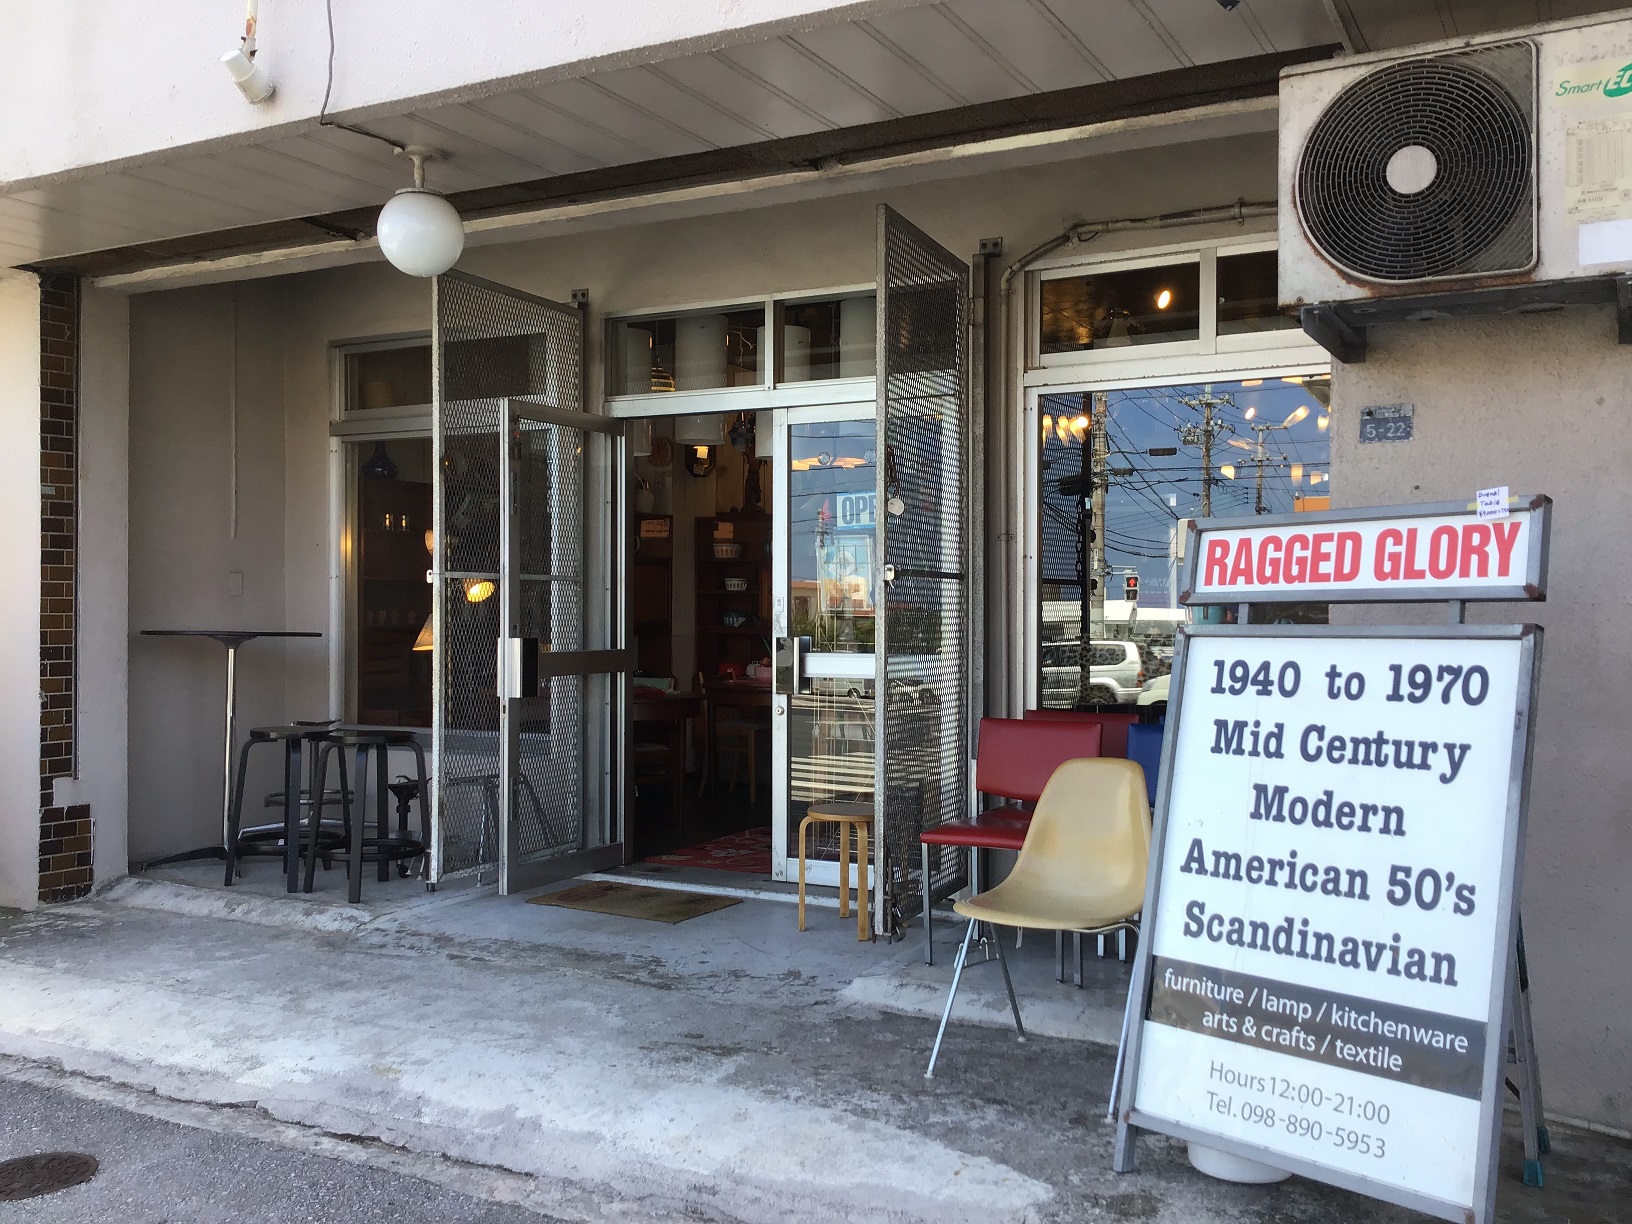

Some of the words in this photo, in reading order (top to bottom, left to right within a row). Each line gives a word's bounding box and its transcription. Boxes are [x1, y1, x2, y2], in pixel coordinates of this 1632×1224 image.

[1555, 79, 1602, 97] Smart
[1204, 531, 1362, 586] RAGGED
[1374, 521, 1522, 582] GLORY
[1210, 659, 1301, 698] 1940
[1325, 664, 1366, 701] to
[1386, 663, 1490, 706] 1970
[1210, 719, 1285, 760] Mid
[1300, 724, 1472, 784] Century
[1250, 783, 1406, 837] Modern
[1179, 838, 1370, 901] American
[1386, 864, 1476, 916] 50's
[1183, 900, 1458, 987] Scandinavian
[1164, 968, 1245, 1005] furniture
[1261, 988, 1312, 1021] lamp
[1331, 1003, 1469, 1053] kitchenware
[1202, 1011, 1238, 1033] arts
[1241, 1018, 1257, 1038] &
[1261, 1026, 1316, 1052] crafts
[1335, 1039, 1403, 1072] textile
[1207, 1090, 1237, 1118] Tel.
[1241, 1101, 1386, 1158] 098-890-5953
[1209, 1059, 1265, 1093] Hours
[1270, 1077, 1390, 1124] 12:00-21:00
